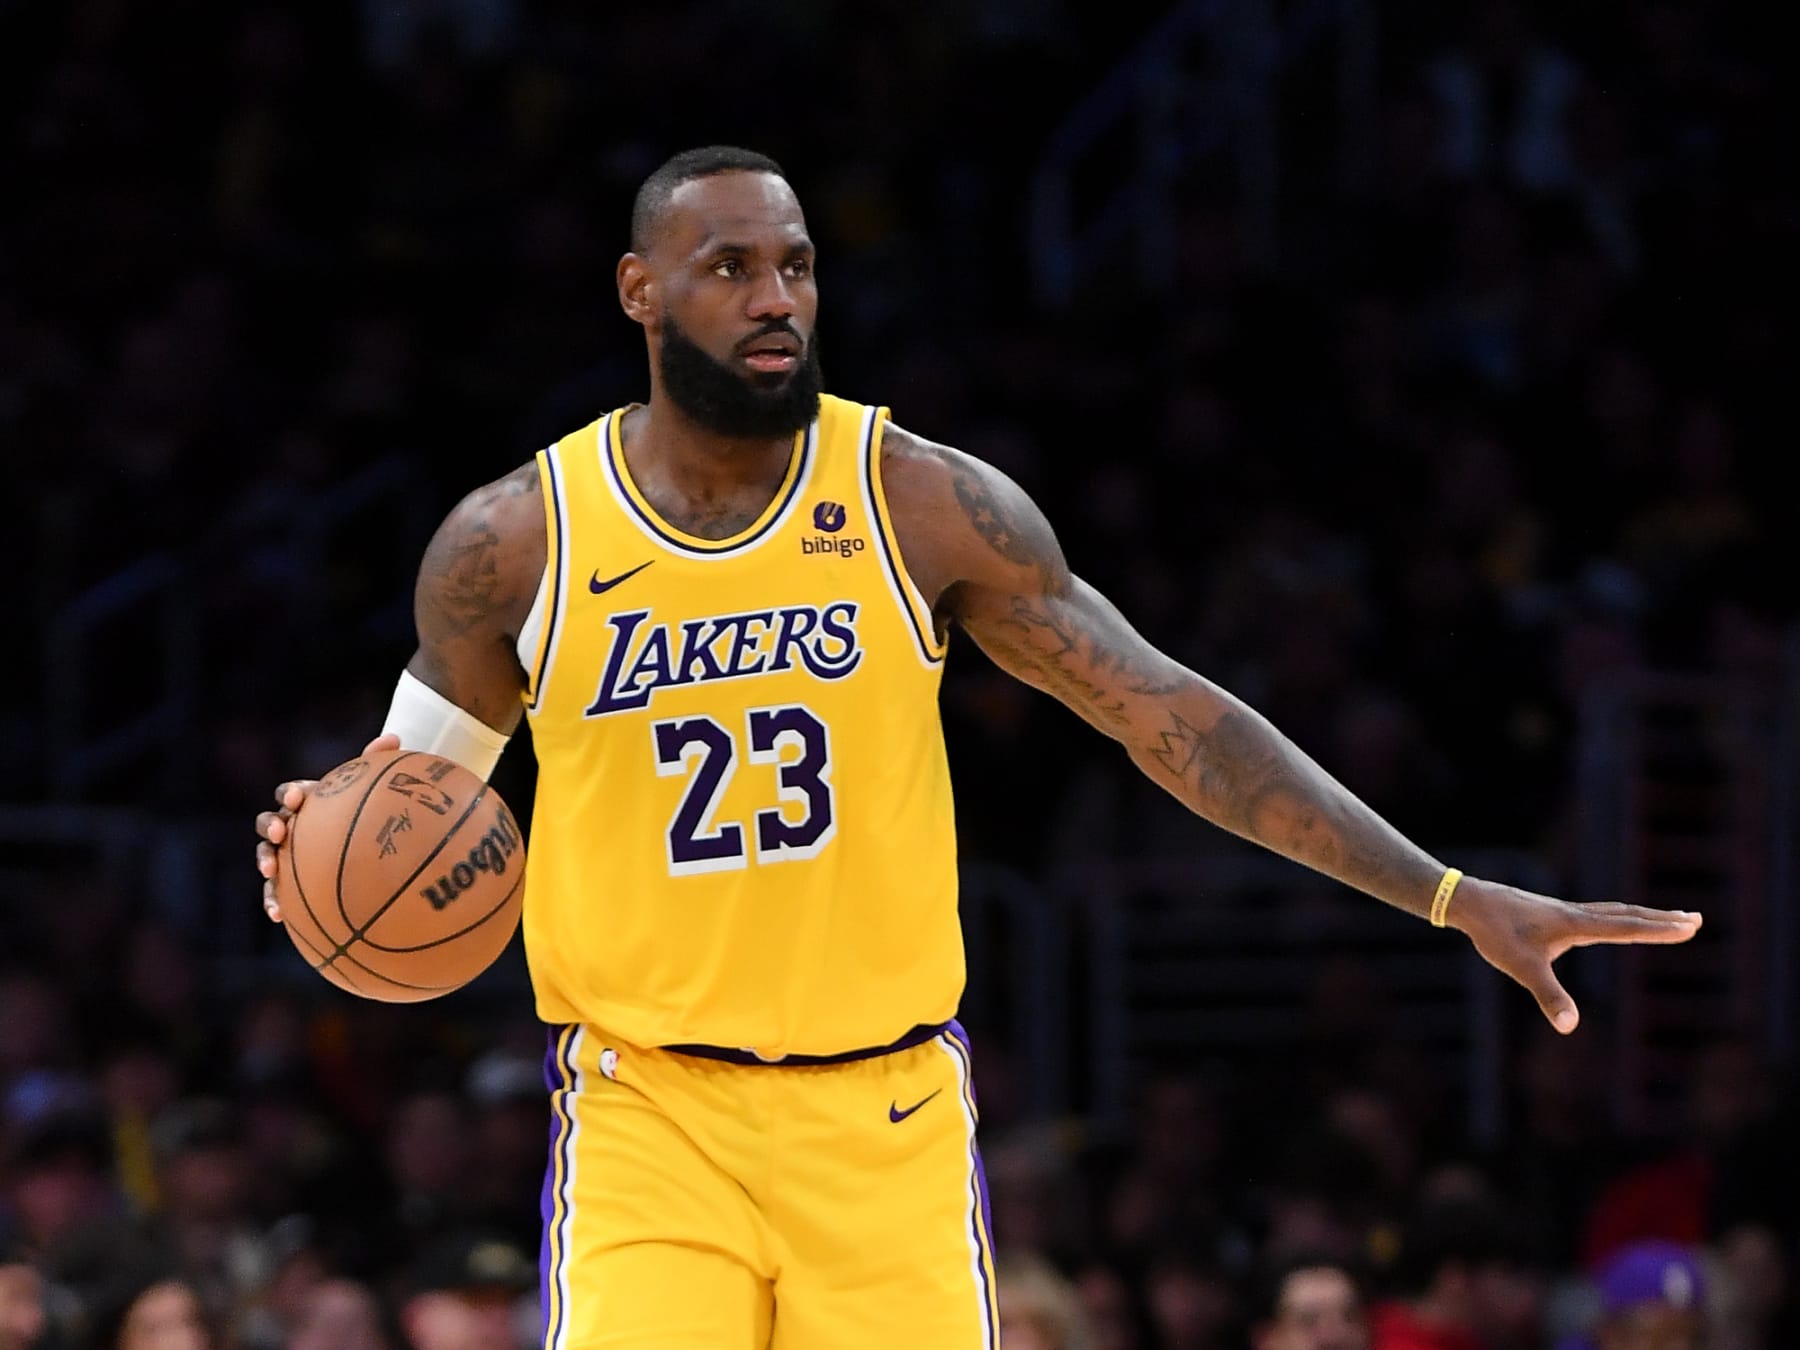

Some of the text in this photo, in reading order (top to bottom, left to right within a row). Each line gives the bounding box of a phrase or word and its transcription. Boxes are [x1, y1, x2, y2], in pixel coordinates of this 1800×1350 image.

[801, 535, 865, 558] bibigo
[583, 602, 864, 719] LAKERS
[651, 703, 837, 877] 23
